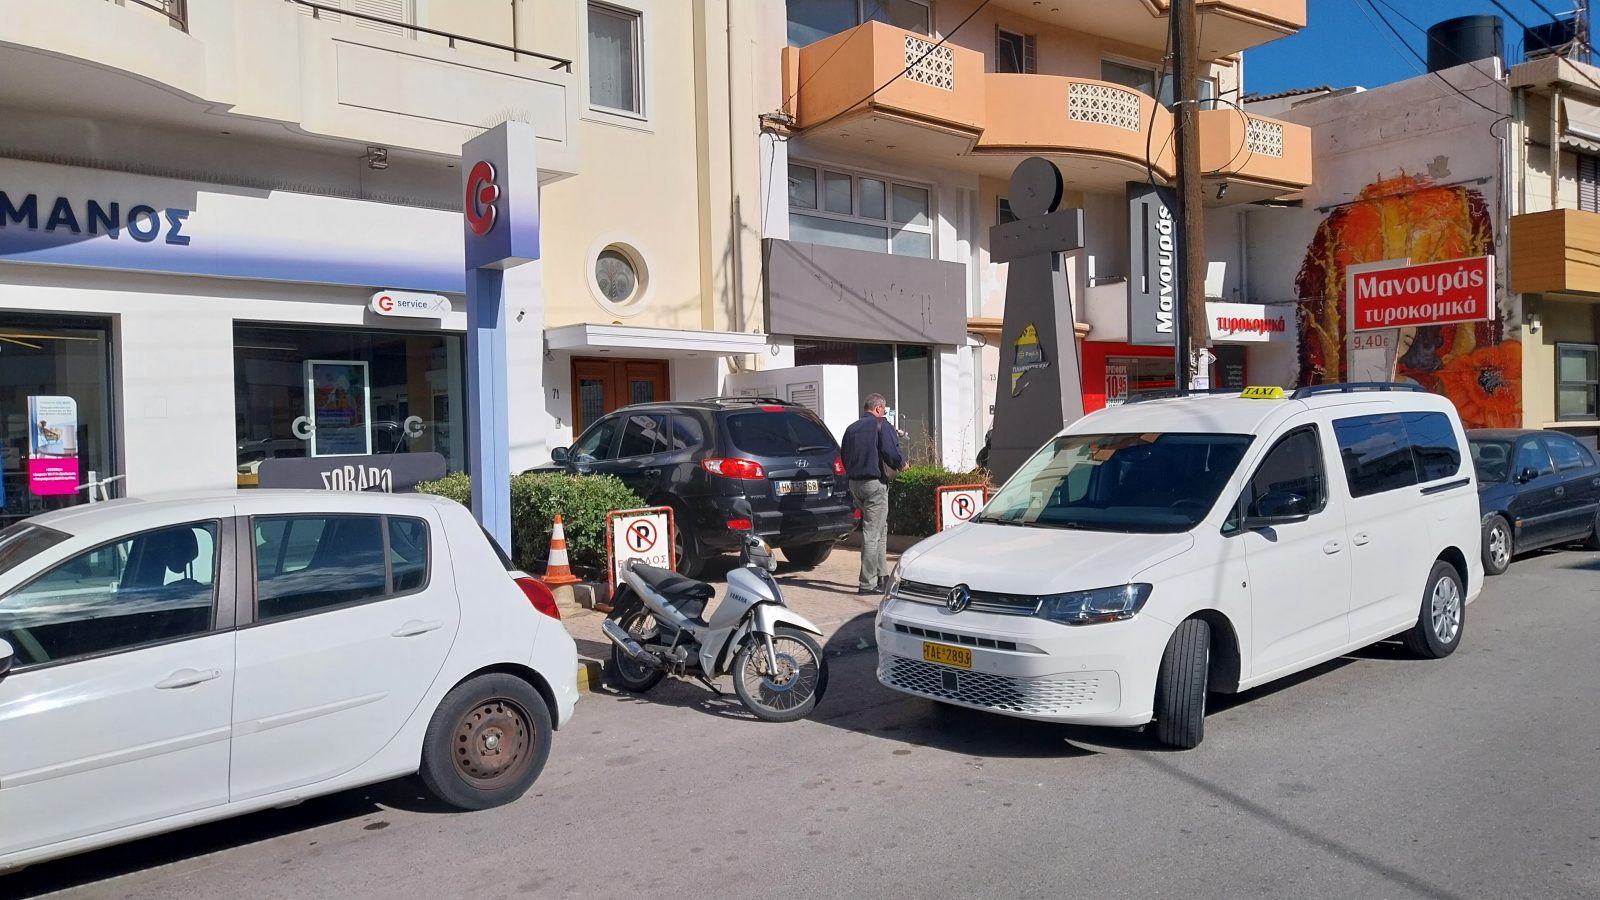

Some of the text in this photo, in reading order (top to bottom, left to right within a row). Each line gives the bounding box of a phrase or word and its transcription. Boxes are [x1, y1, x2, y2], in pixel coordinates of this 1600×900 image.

[397, 299, 428, 309] service
[1364, 295, 1477, 325] τυροκομικά
[1216, 316, 1285, 336] τυροκομικά
[552, 388, 560, 399] 71
[1245, 387, 1276, 395] TAXI
